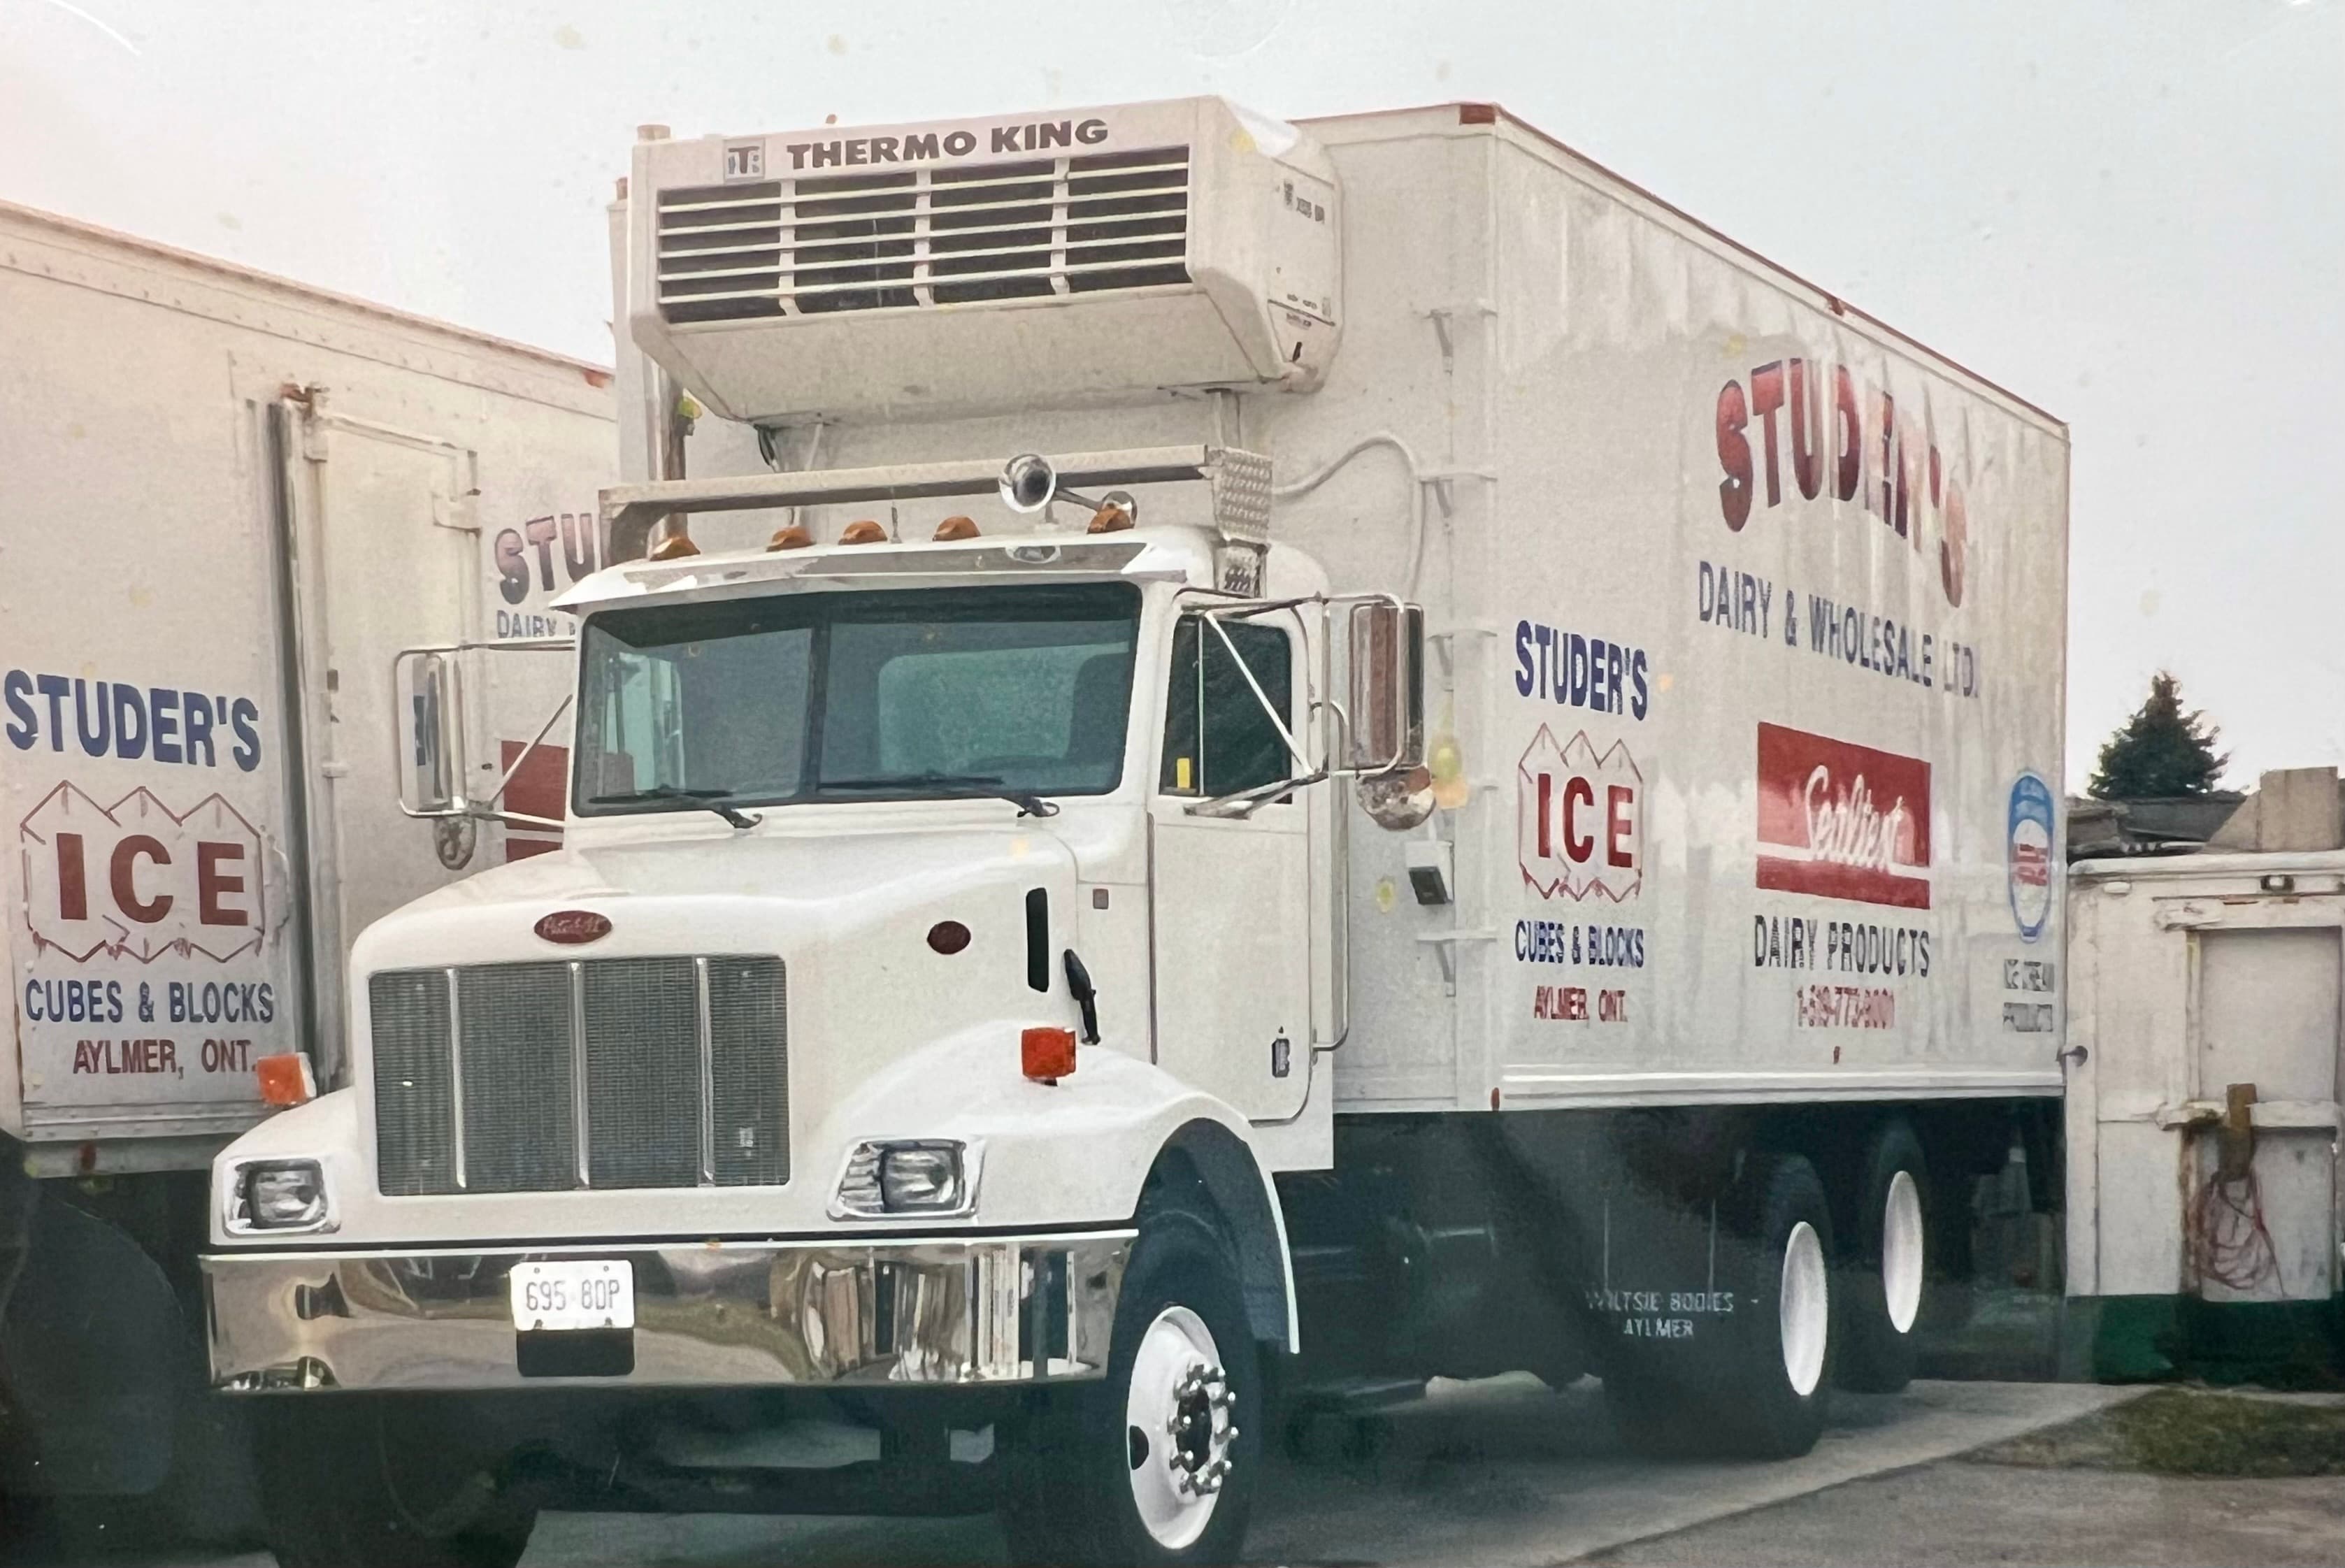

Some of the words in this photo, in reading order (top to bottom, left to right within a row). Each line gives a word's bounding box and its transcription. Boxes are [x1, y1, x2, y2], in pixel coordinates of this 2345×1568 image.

[787, 131, 977, 169] THERMO
[991, 119, 1108, 152] KING
[495, 513, 609, 605] STU
[497, 610, 557, 638] DAIRY
[1700, 561, 1772, 638] DAIRY
[1784, 590, 1797, 646] &
[1809, 594, 1932, 687] WHOLESALE
[1516, 620, 1648, 721] STUDER'S
[3, 669, 261, 772] STUDER'S
[1537, 773, 1633, 868] ICE
[57, 833, 248, 926] ICE
[1515, 919, 1564, 963] CUBES
[1572, 926, 1581, 965] &
[1589, 926, 1644, 968] BLOCKS
[1755, 914, 1818, 970] DAIRY
[1827, 921, 1930, 977] PRODUCTS
[25, 979, 122, 1022] CUBES
[139, 982, 155, 1022] &
[168, 982, 274, 1023] BLOCKS
[73, 1040, 184, 1079] AYLMER,
[201, 1039, 257, 1074] ONT.
[526, 1281, 566, 1311] 695
[1623, 1318, 1693, 1338] AYLMER
